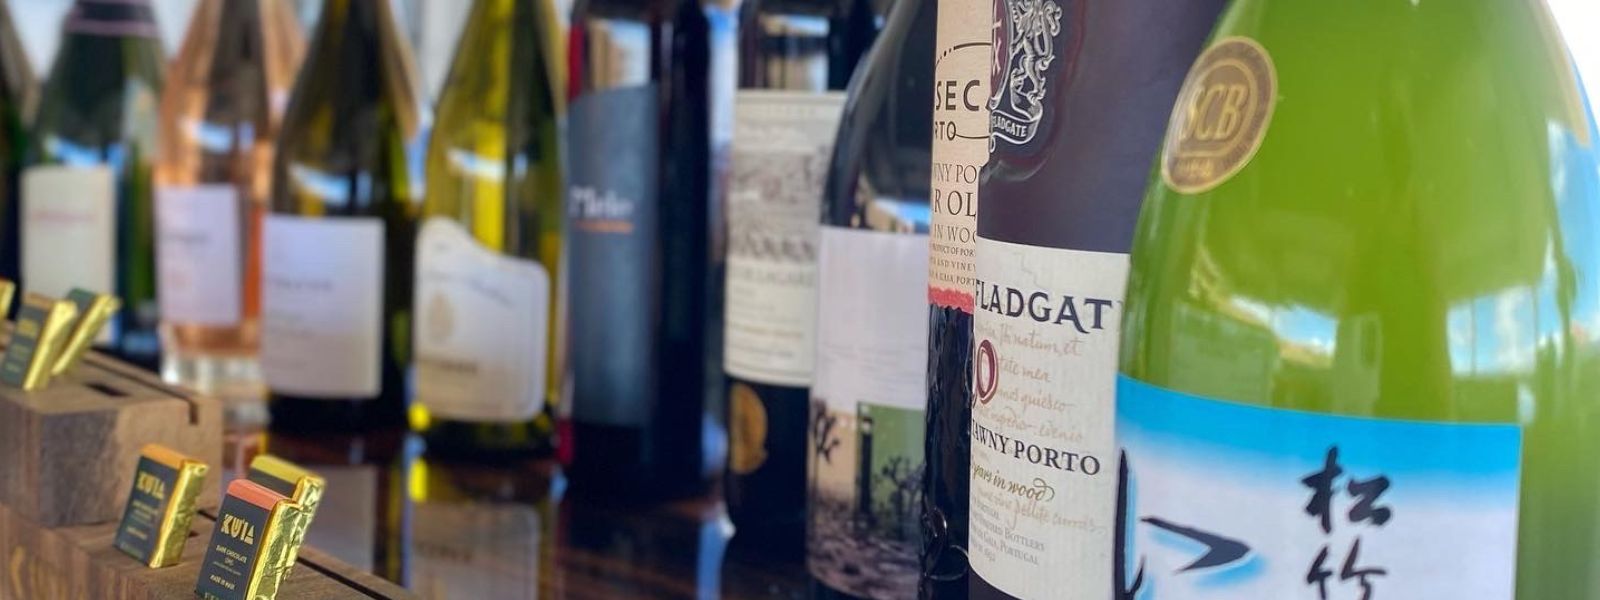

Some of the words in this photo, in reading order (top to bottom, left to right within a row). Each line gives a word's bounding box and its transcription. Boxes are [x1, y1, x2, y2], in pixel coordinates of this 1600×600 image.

[935, 79, 992, 112] SEC
[1178, 82, 1249, 142] SCB
[955, 165, 981, 184] PO
[976, 279, 1122, 334] FLADGAT
[1014, 439, 1100, 475] PORTO
[1008, 477, 1055, 502] wood
